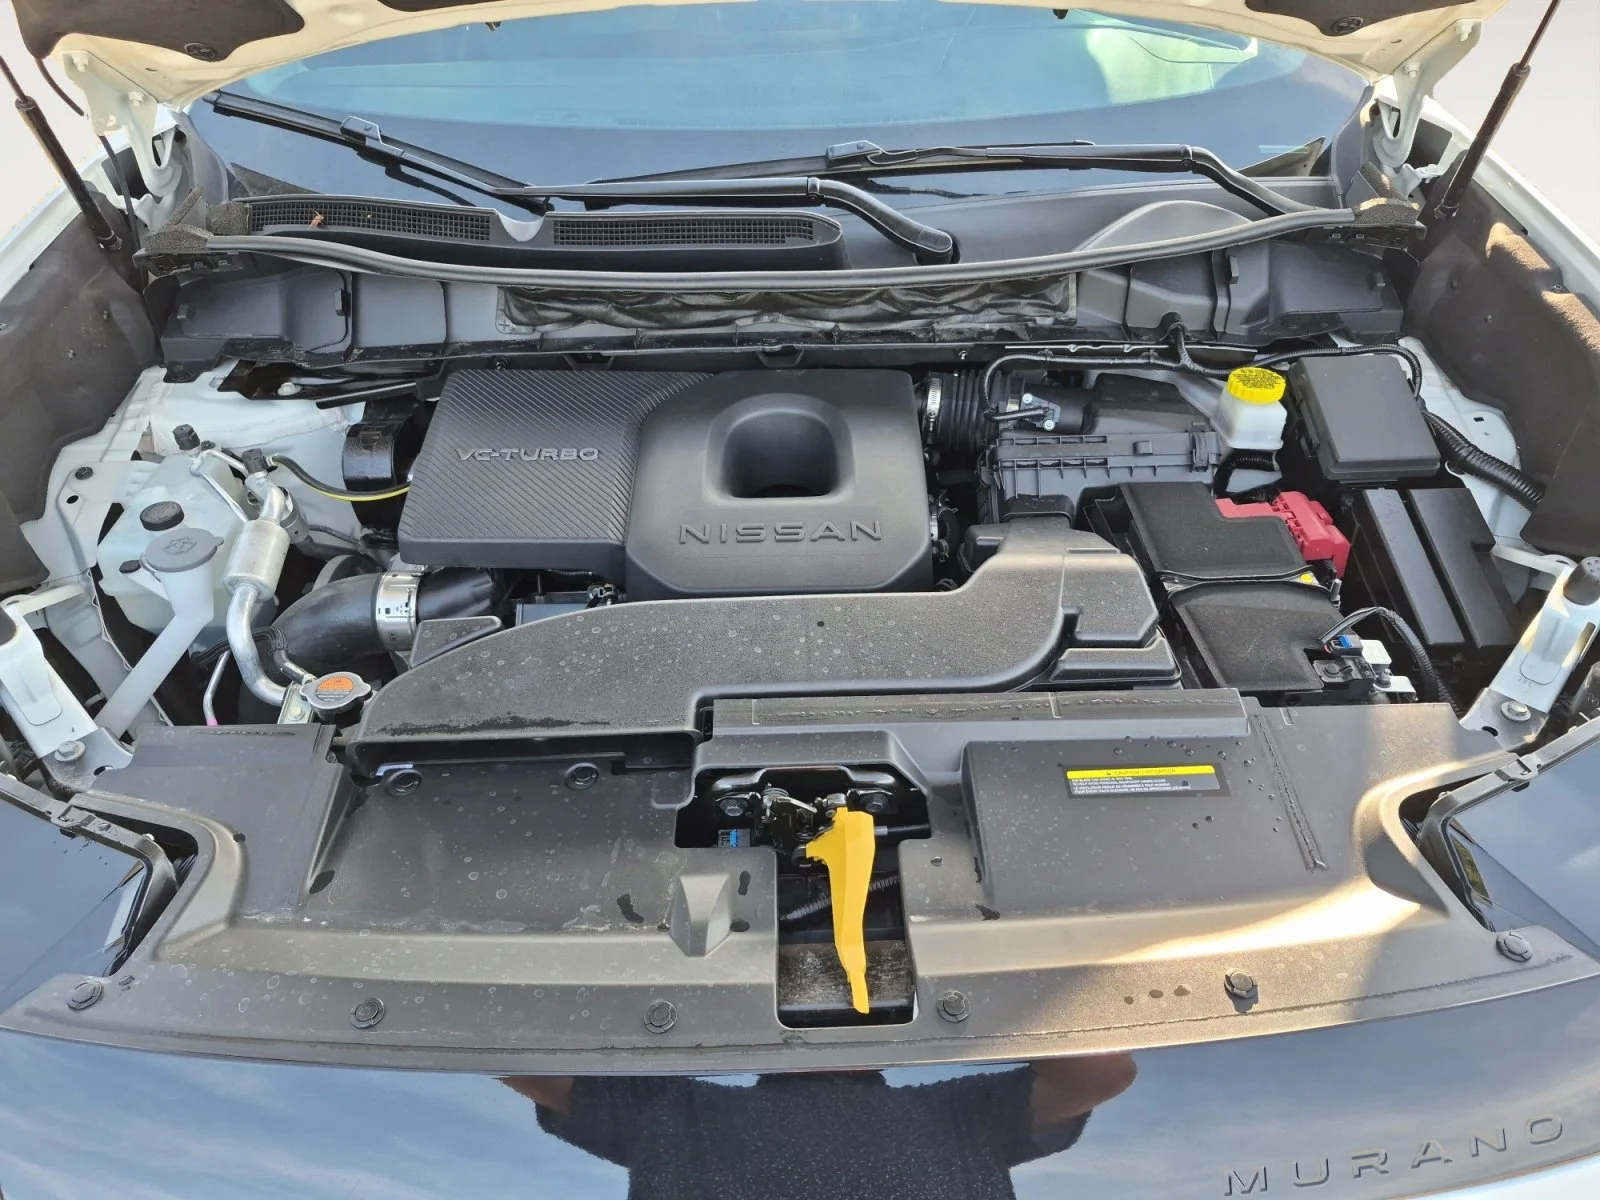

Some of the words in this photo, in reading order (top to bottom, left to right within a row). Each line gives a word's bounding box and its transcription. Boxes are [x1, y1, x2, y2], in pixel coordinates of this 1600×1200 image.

[455, 447, 600, 461] VC-TURBO
[679, 520, 882, 545] NISSAN
[1222, 1113, 1563, 1196] MURANO
